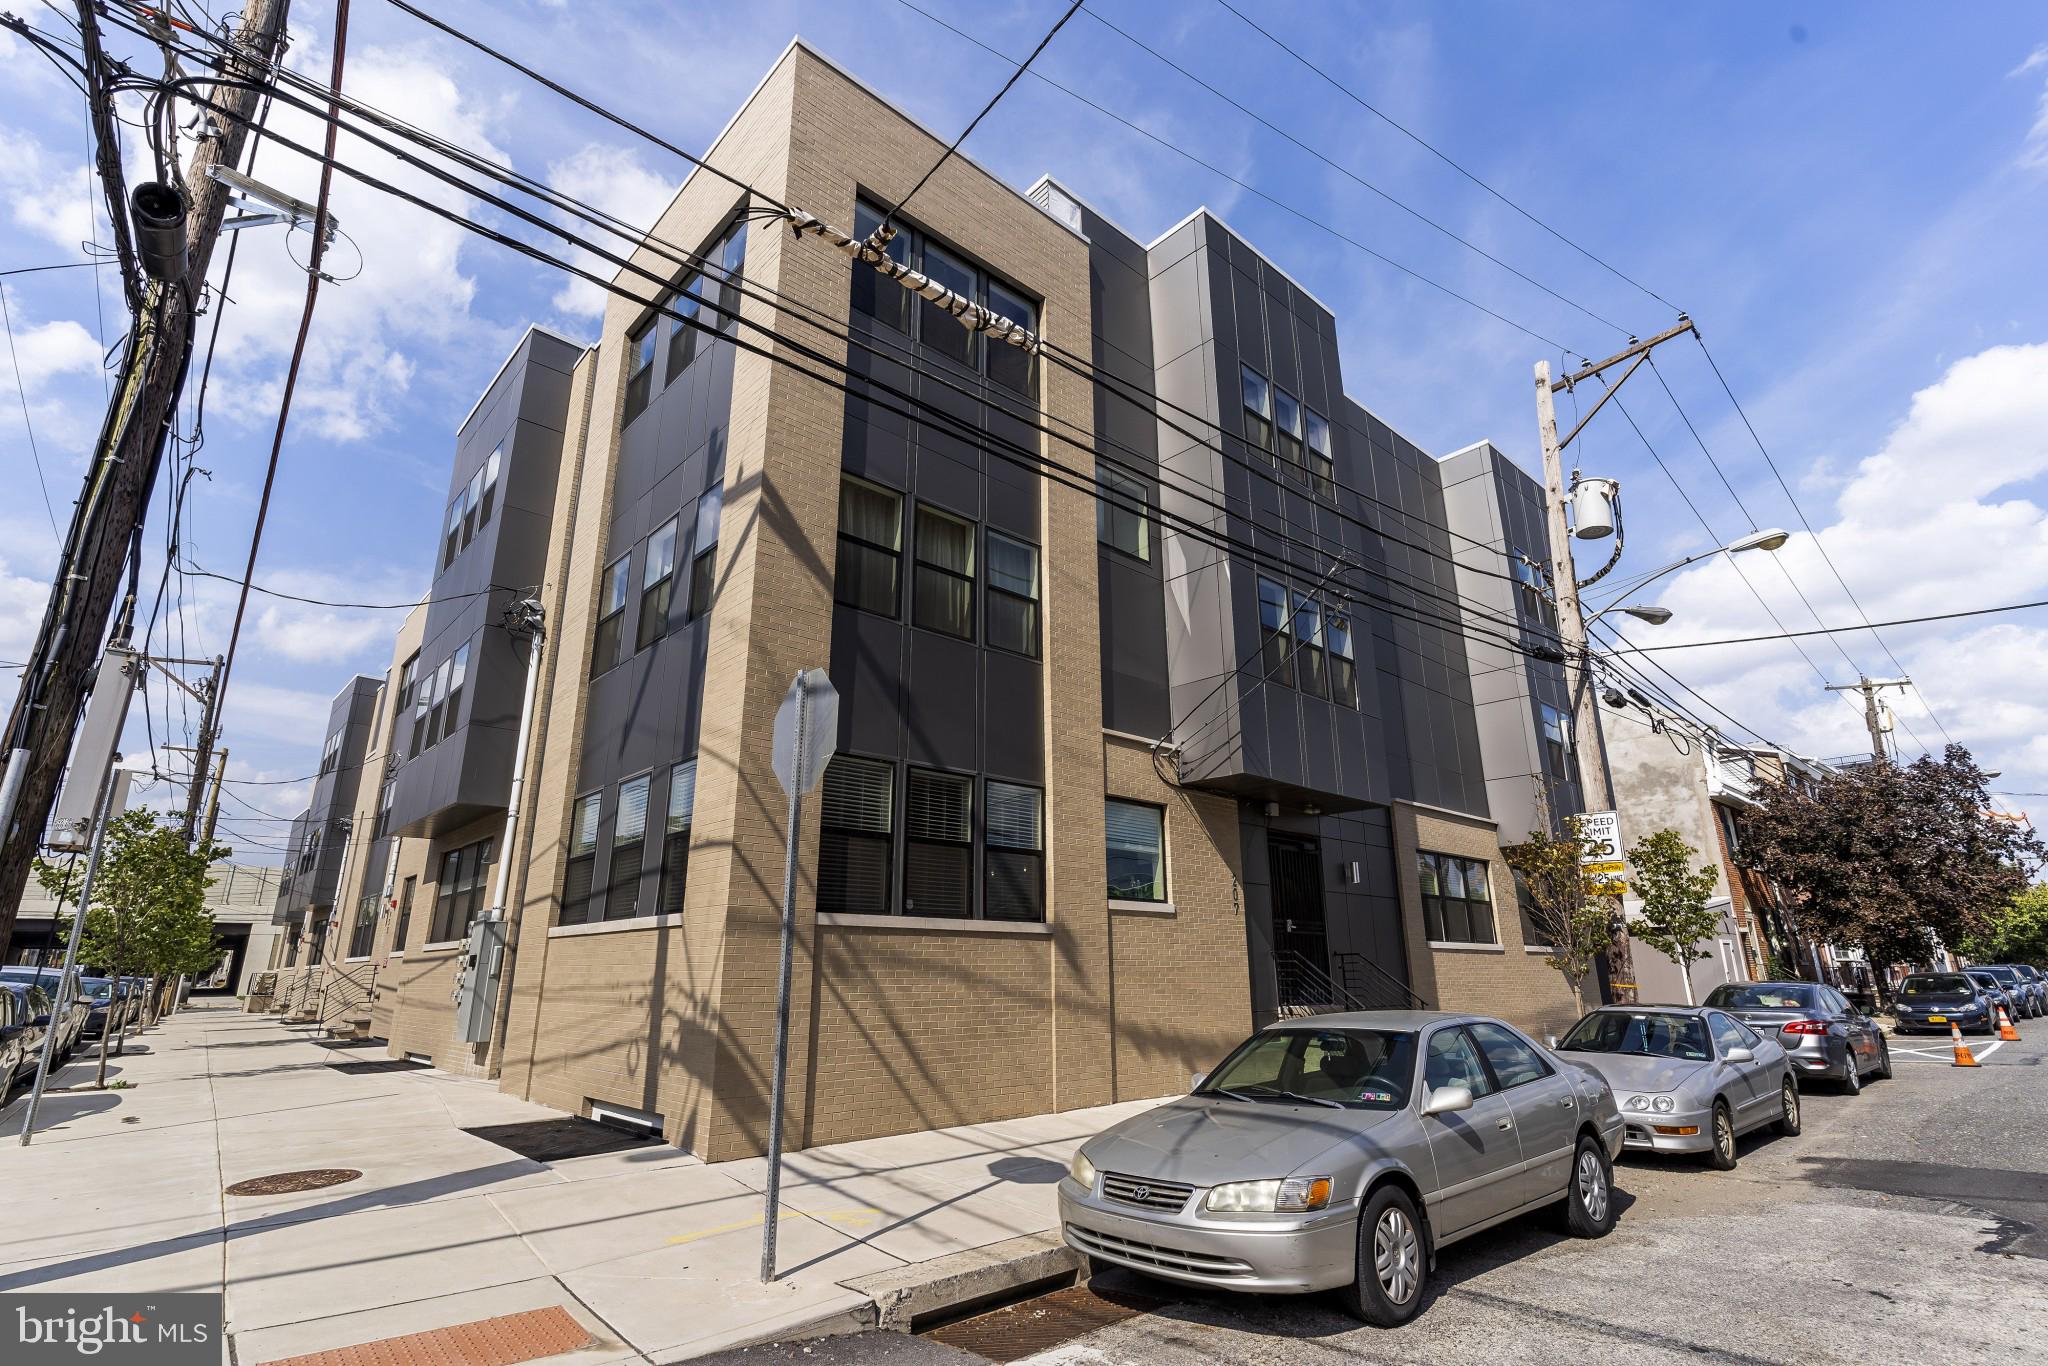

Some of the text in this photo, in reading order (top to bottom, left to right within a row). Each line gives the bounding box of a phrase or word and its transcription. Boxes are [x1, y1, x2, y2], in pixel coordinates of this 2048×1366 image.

[1580, 817, 1614, 828] SPEED
[1584, 827, 1611, 837] LIMIT
[1584, 838, 1615, 857] 25
